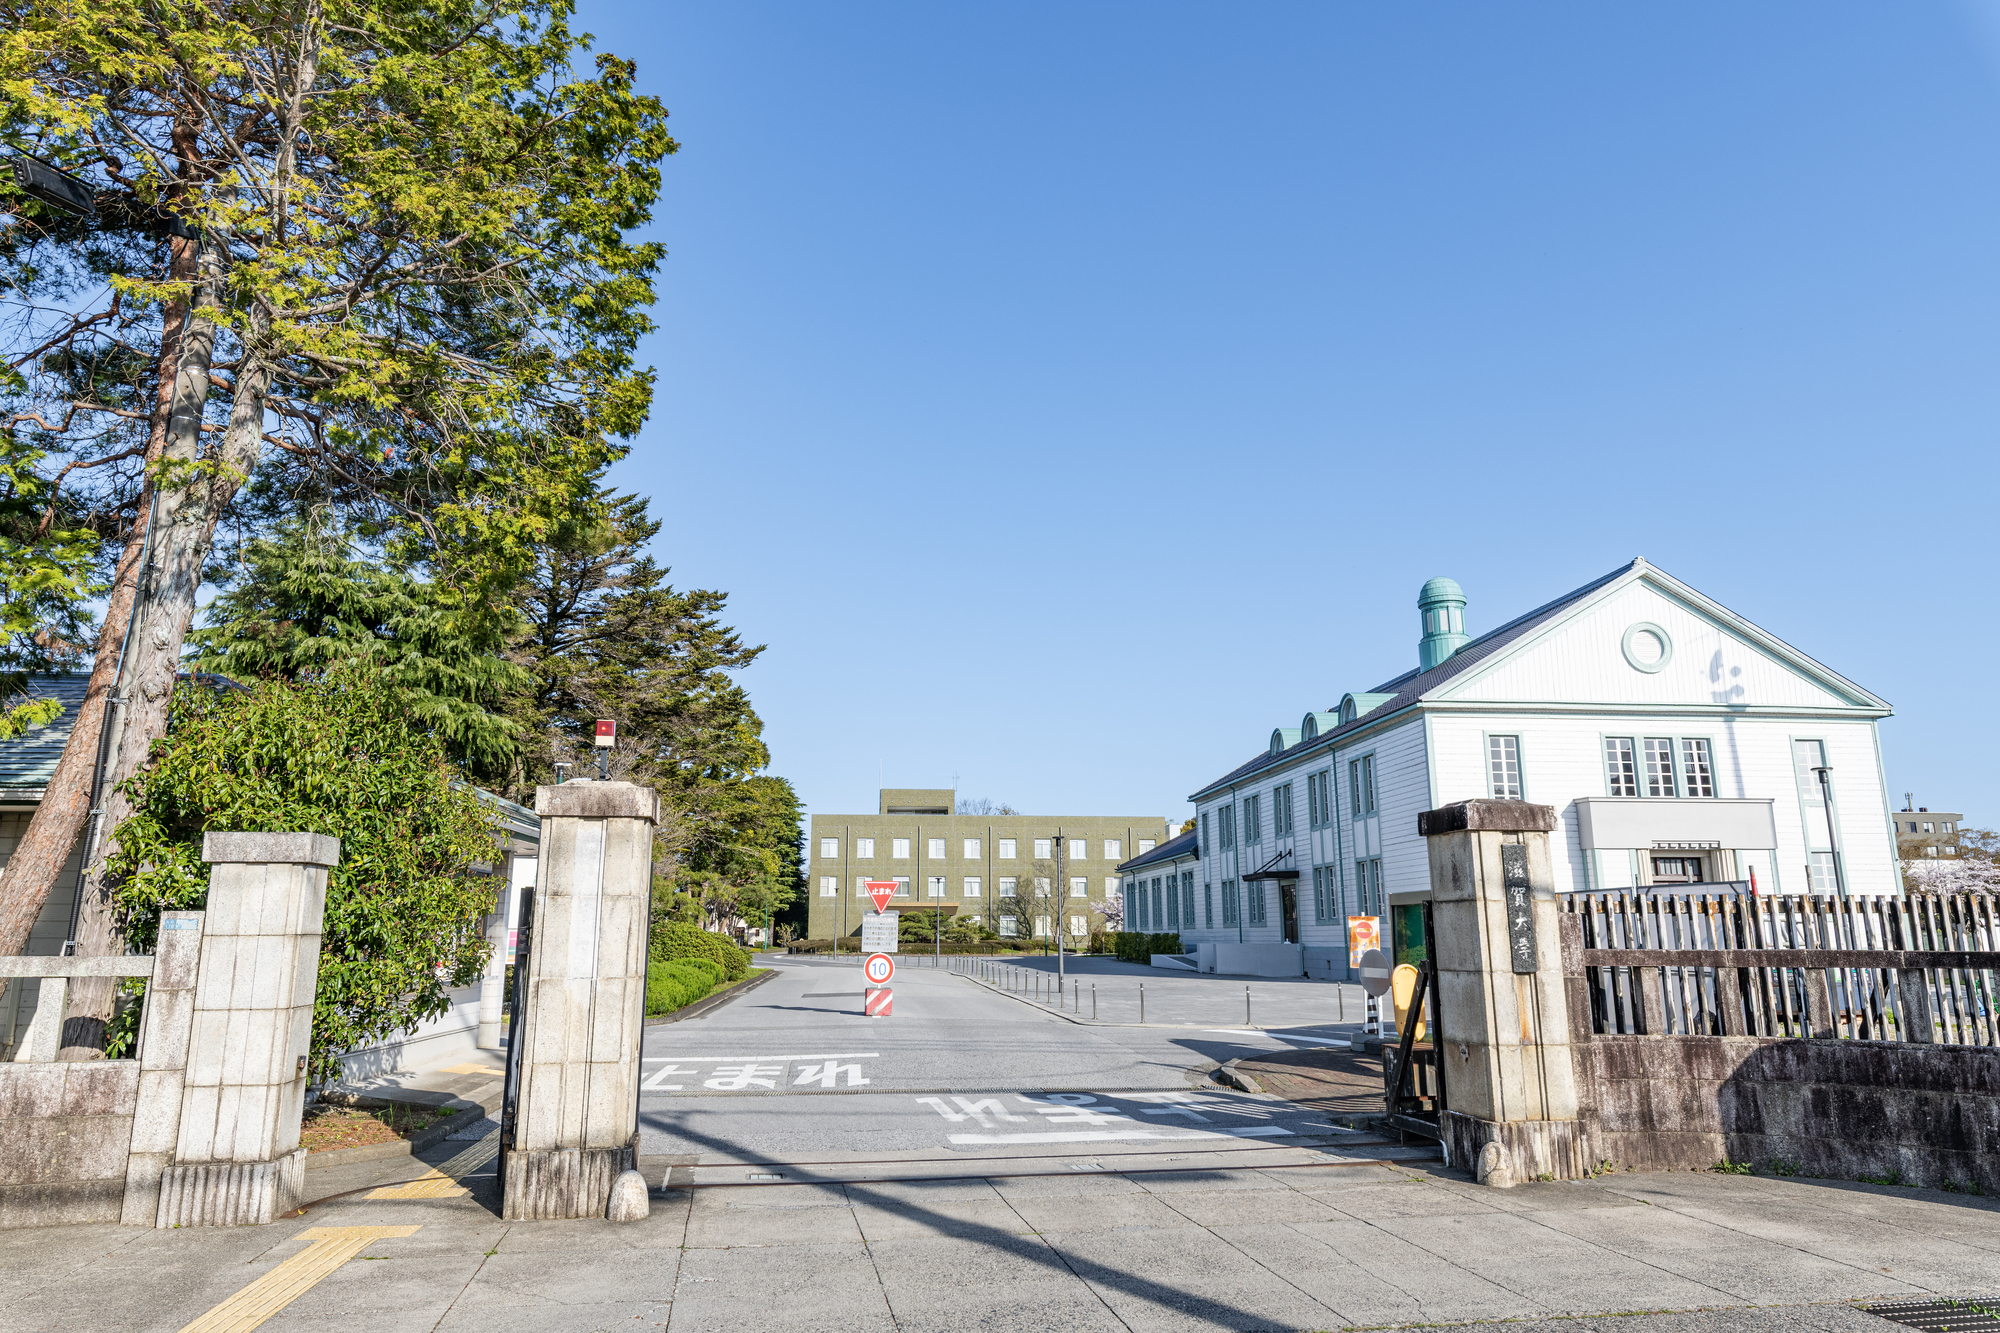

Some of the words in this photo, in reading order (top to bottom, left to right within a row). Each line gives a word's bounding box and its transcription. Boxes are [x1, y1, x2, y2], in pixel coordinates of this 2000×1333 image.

[872, 887, 892, 895] 止まれ
[871, 963, 887, 976] 10
[642, 1060, 871, 1090] 止まれ
[915, 1092, 1212, 1128] 止まれ
